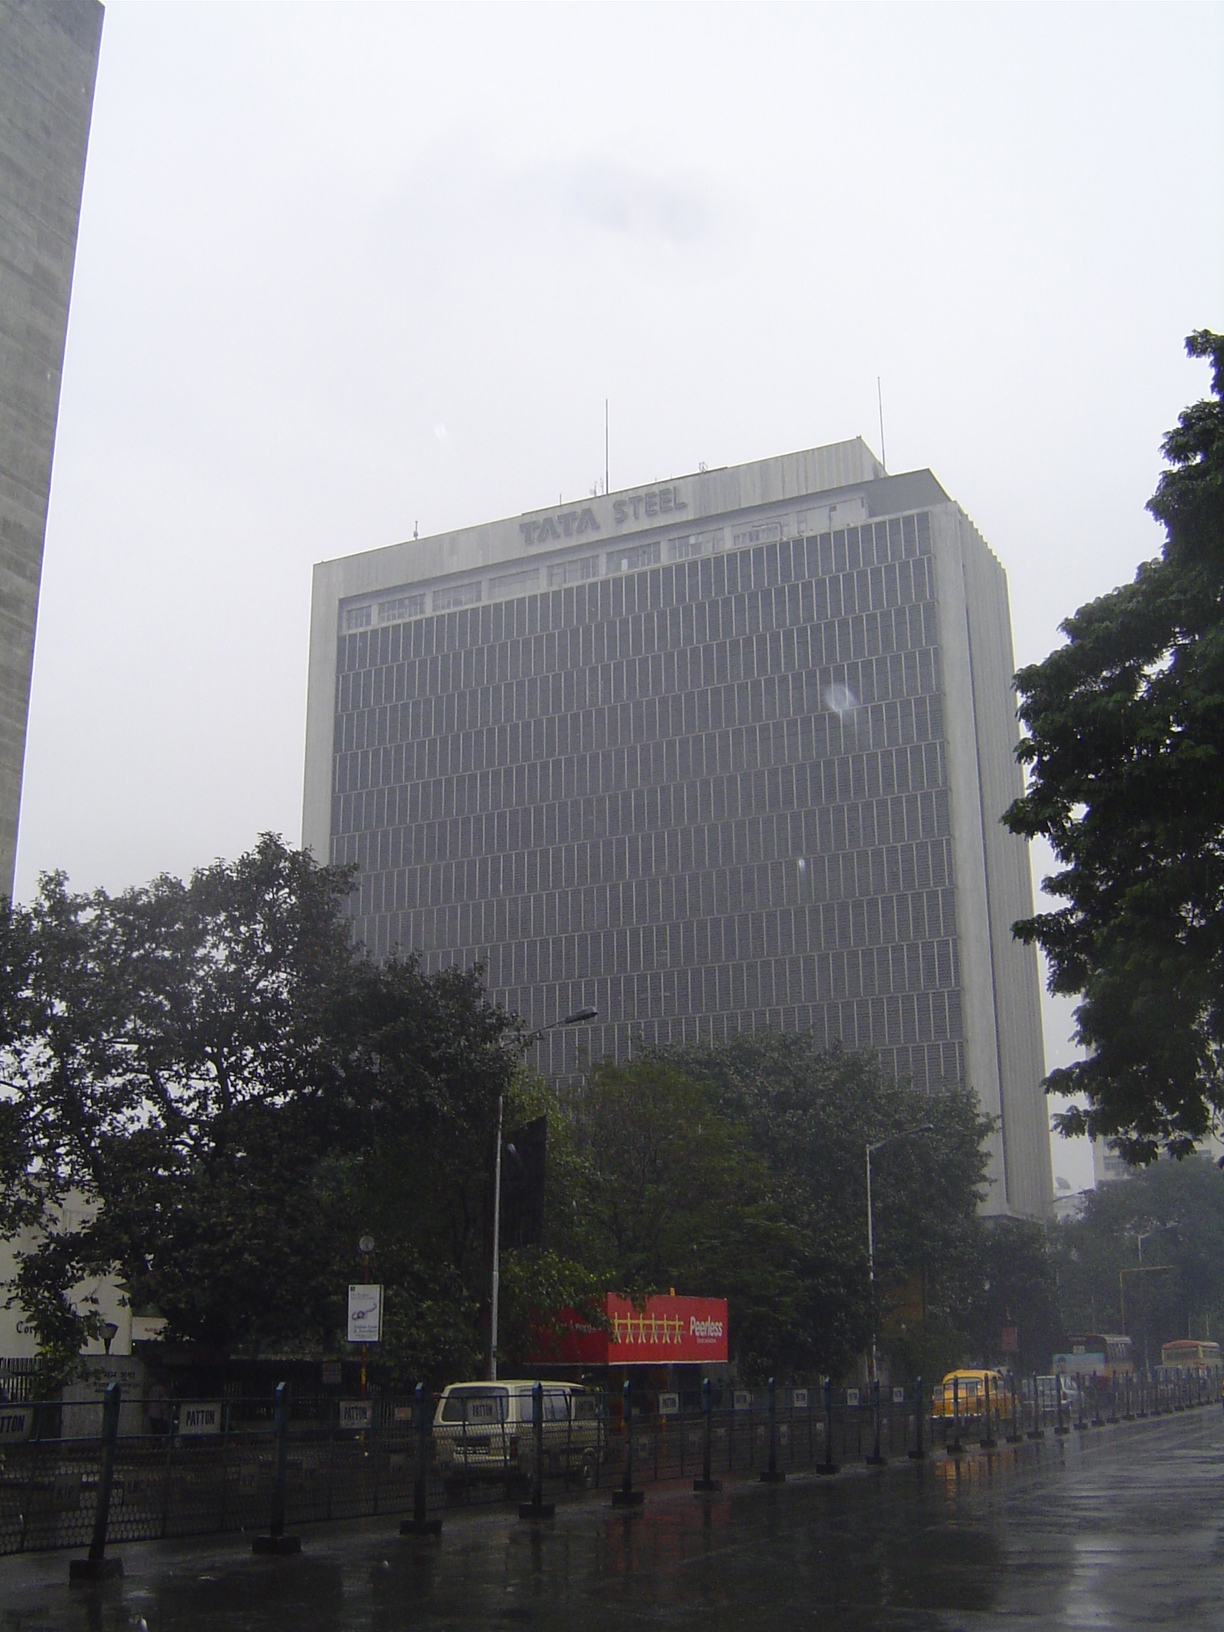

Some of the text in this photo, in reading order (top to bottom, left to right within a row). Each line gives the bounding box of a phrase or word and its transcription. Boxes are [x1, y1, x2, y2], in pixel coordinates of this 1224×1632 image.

[518, 485, 688, 545] TATA STEEL
[689, 1315, 723, 1338] Peerless
[186, 1409, 215, 1426] PATTON
